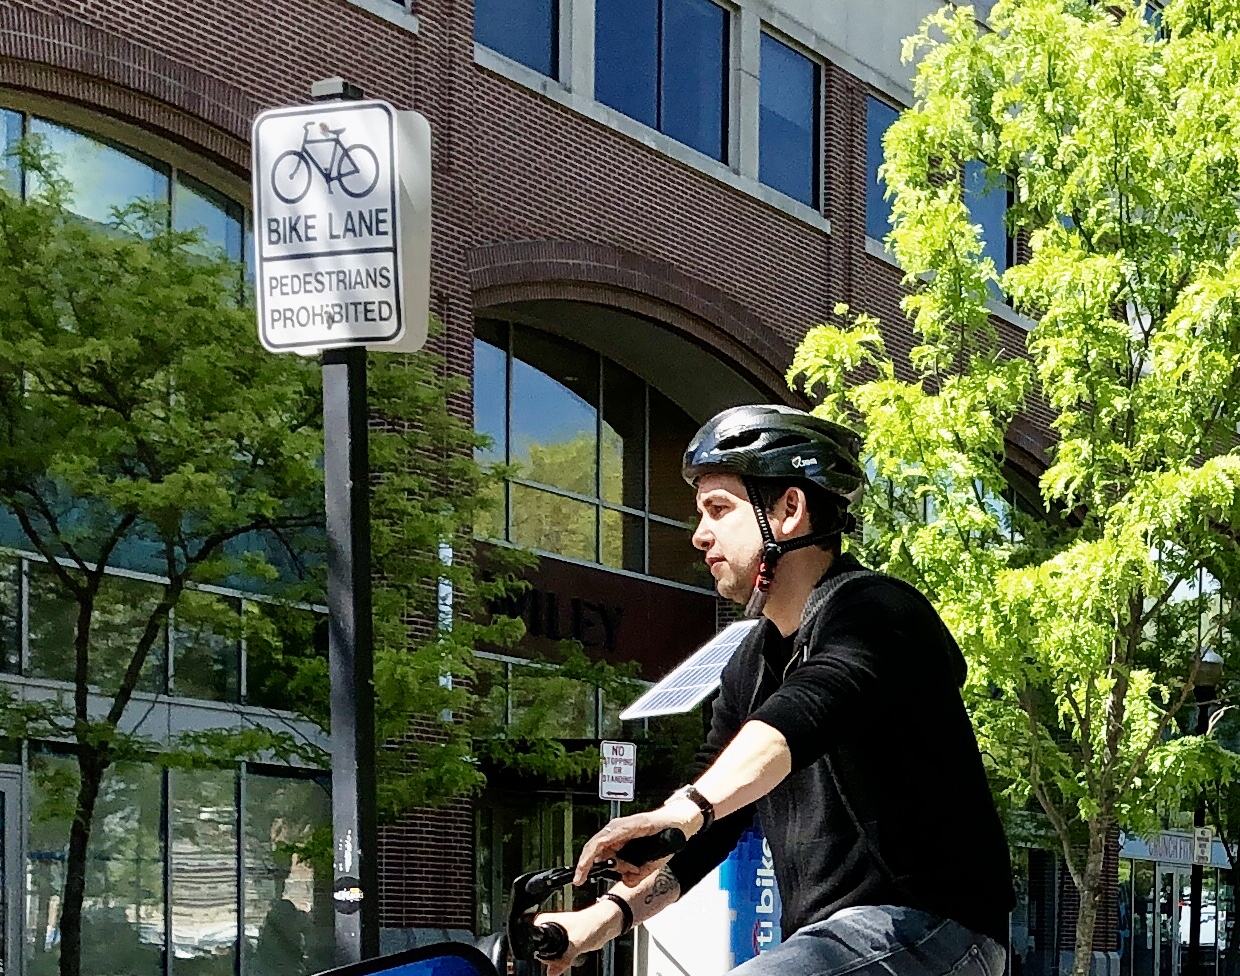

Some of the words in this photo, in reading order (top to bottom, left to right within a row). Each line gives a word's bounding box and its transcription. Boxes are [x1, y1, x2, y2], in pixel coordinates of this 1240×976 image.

[267, 214, 318, 246] BIKE
[328, 208, 389, 240] LANE
[269, 266, 392, 297] PEDESTRIANS
[270, 300, 393, 330] PROHIBITED
[611, 745, 625, 757] NO
